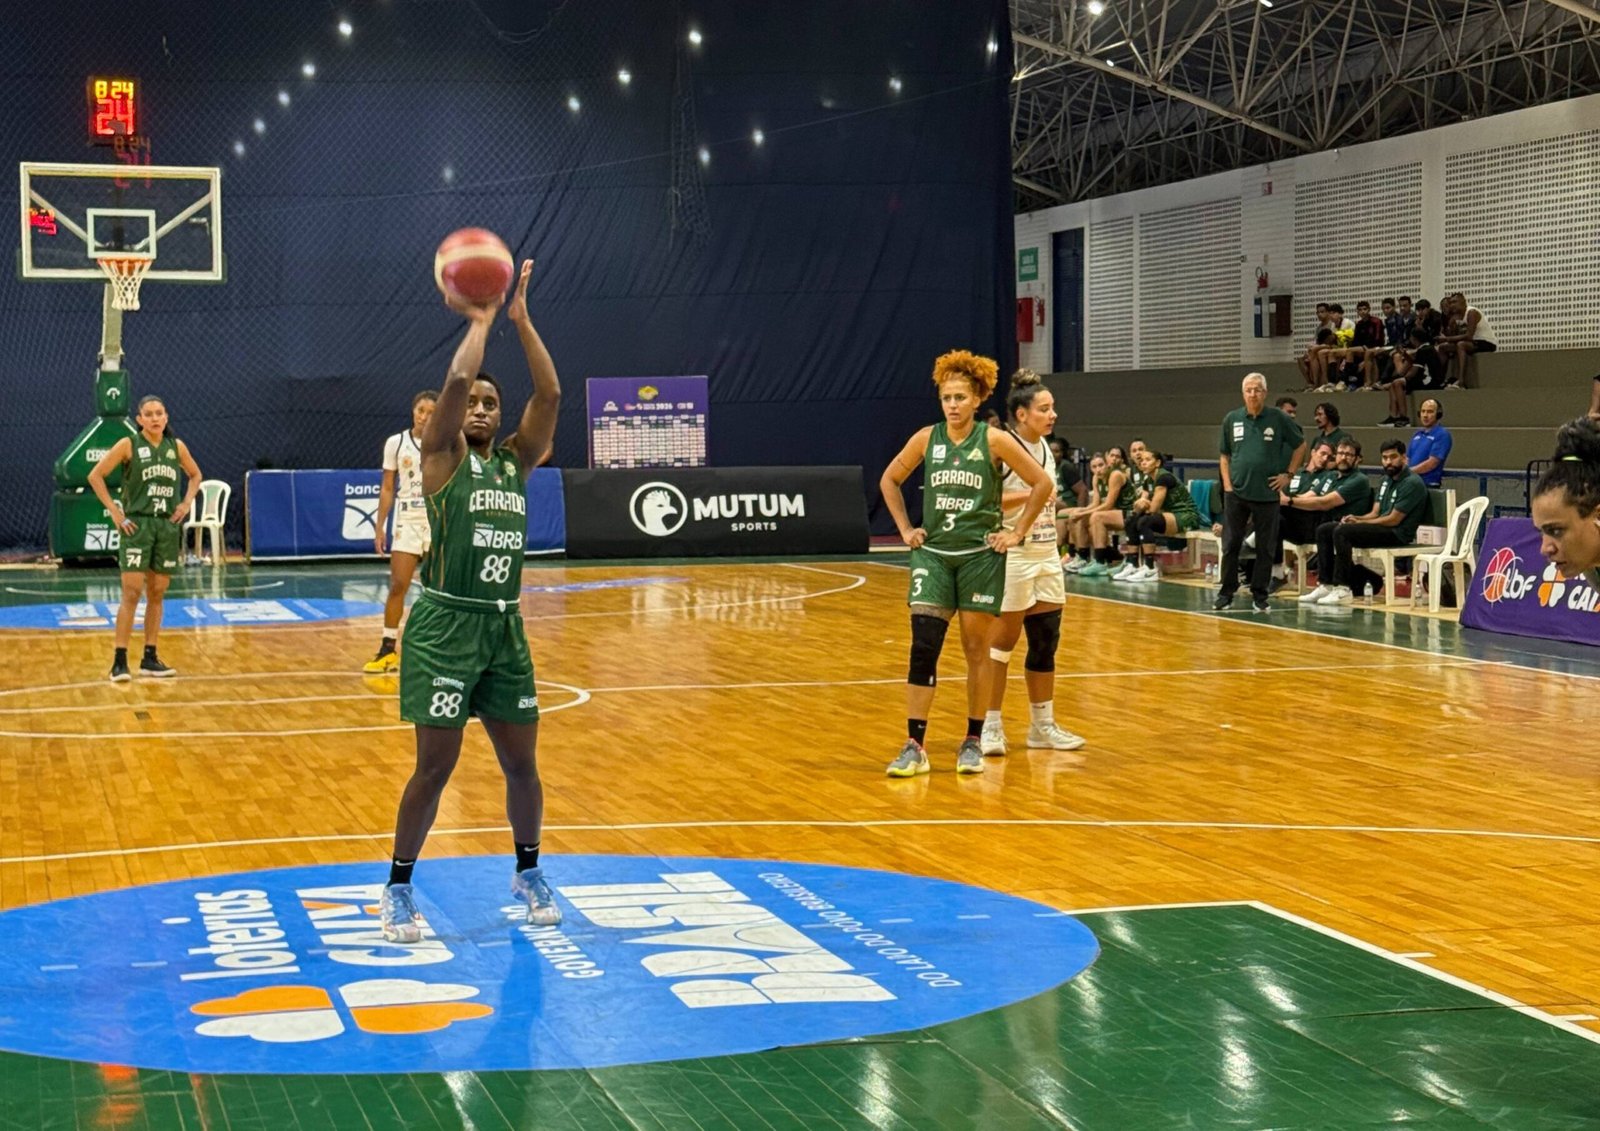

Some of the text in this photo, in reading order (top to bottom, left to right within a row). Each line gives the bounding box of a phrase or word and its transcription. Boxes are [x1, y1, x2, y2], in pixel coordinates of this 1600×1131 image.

[96, 98, 134, 135] 24
[142, 464, 177, 481] CERRADO
[930, 469, 983, 490] CERRADO
[152, 498, 167, 512] 74
[469, 489, 526, 516] CERRADO
[693, 494, 805, 521] MUTUM
[946, 497, 974, 512] BRB
[731, 522, 777, 531] SPORTS
[942, 513, 957, 531] 3
[492, 530, 523, 550] BRB
[126, 554, 142, 568] 74
[480, 554, 512, 584] 88
[912, 578, 923, 597] 3
[429, 691, 463, 719] 88
[162, 887, 301, 982] loterias
[556, 871, 898, 1009] BRASIL
[757, 872, 963, 988] DO LADO DO POVO BRASILEIRO
